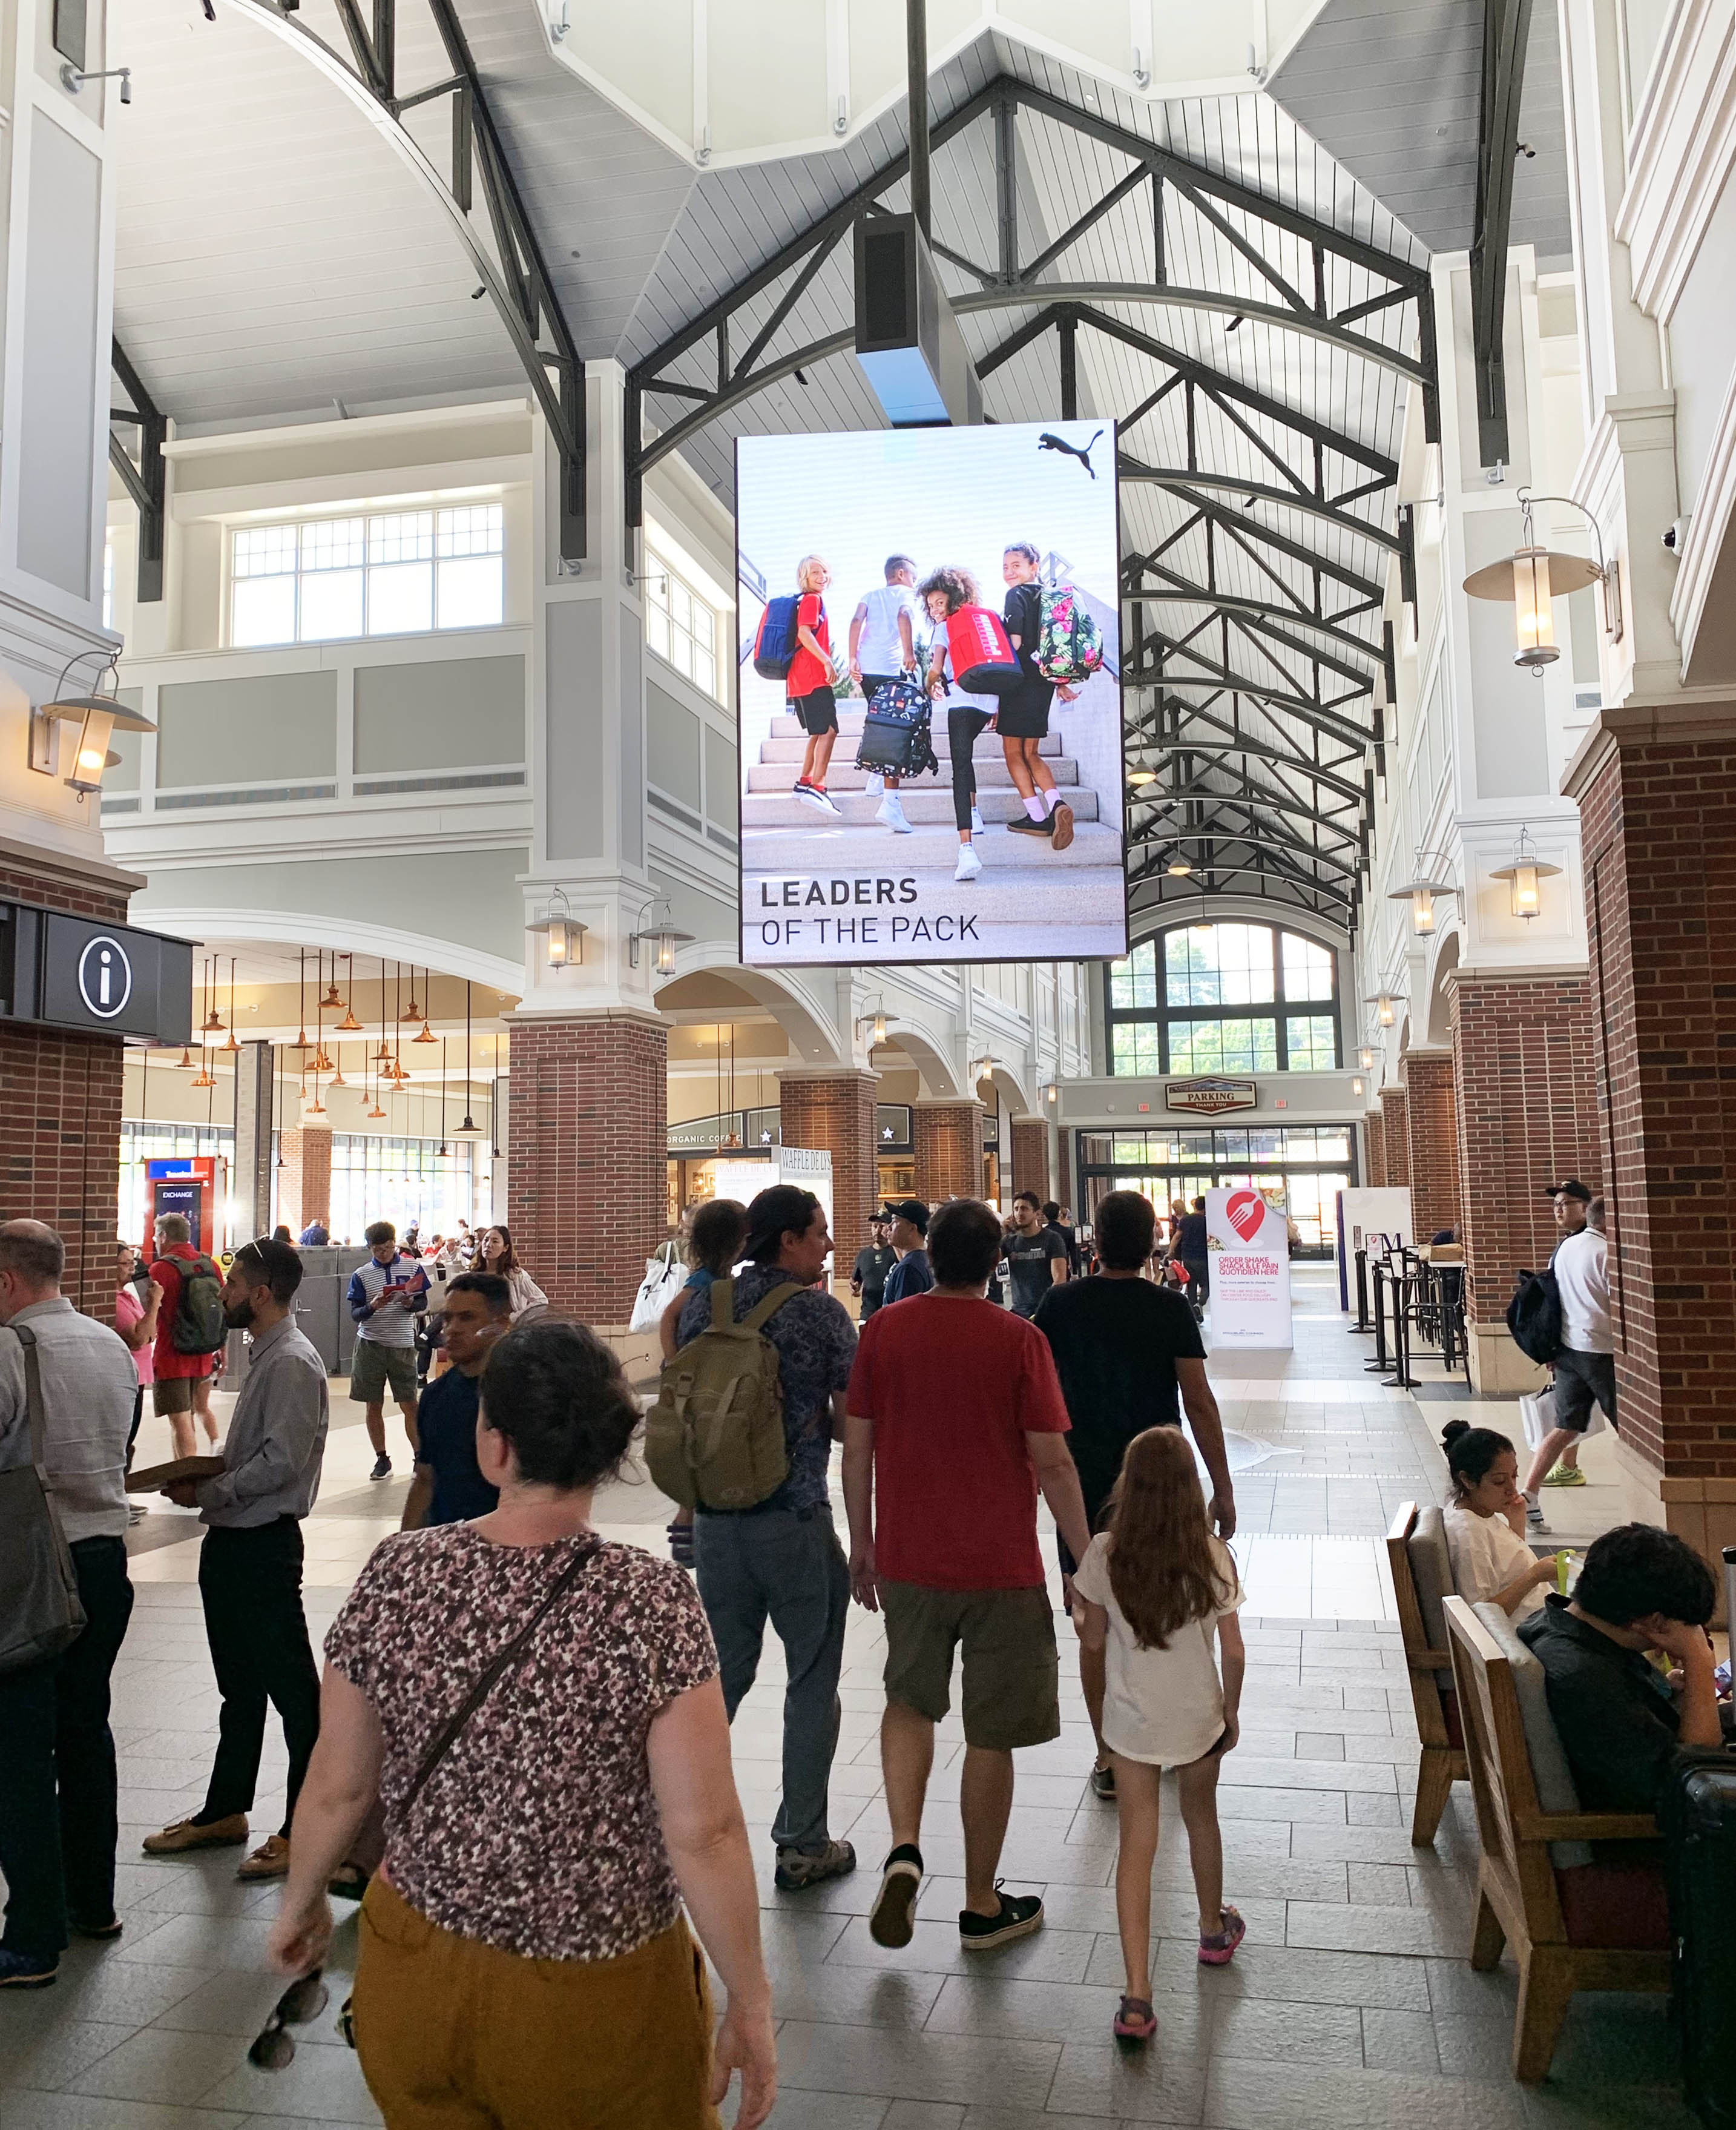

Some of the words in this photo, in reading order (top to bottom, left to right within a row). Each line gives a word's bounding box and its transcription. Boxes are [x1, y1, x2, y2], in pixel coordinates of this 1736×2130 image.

[761, 877, 918, 906] LEADERS
[762, 919, 802, 945] OF
[814, 917, 878, 944] THE
[892, 915, 979, 942] PACK
[1188, 1092, 1234, 1101] PARKING
[666, 1135, 705, 1144] ORGANIC
[782, 1149, 809, 1170] WAFFLE
[811, 1152, 819, 1170] DE
[821, 1152, 831, 1170] LYS
[716, 1165, 749, 1173] WAFFLE
